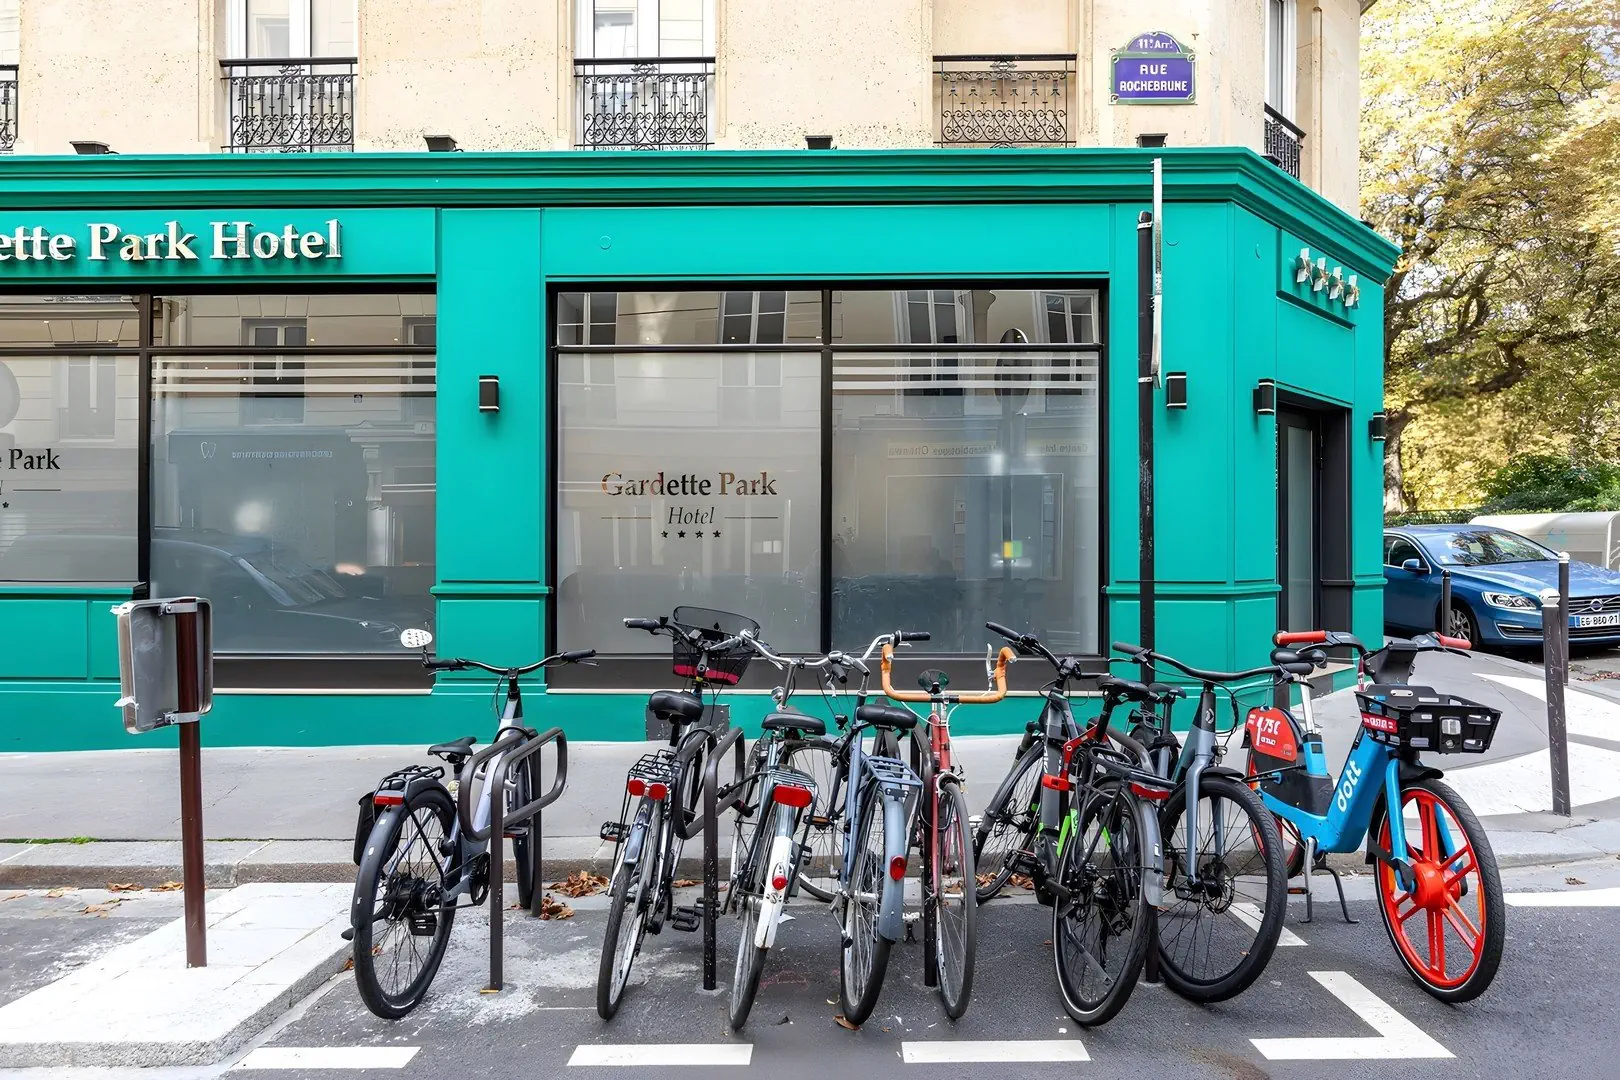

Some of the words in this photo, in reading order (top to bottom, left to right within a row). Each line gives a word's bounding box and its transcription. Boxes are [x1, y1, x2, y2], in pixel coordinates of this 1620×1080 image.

[1139, 64, 1168, 75] RUE
[1119, 80, 1188, 92] ROCHEBRUNE
[87, 220, 199, 261] Park
[209, 218, 343, 260] Hotel
[8, 448, 61, 470] Park
[601, 471, 712, 496] Gardette
[718, 471, 778, 496] Park
[668, 506, 715, 525] Hotel
[1337, 760, 1362, 812] dott
